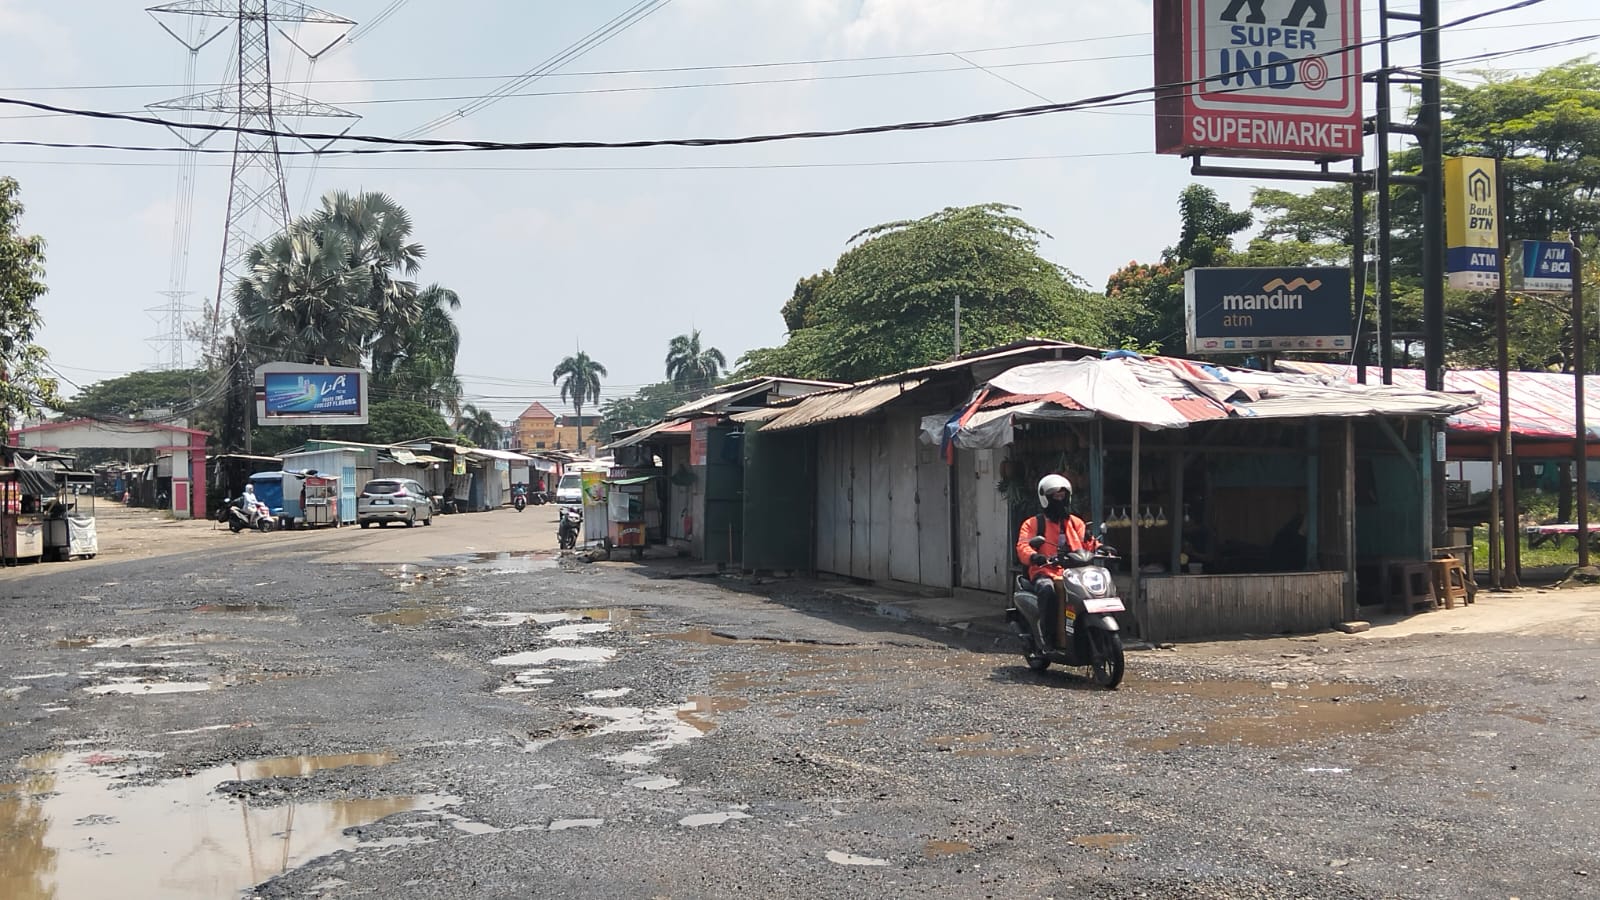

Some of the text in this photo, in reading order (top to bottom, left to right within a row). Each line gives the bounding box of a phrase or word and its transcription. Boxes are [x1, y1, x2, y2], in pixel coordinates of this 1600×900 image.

[1230, 25, 1316, 49] SUPER
[1192, 116, 1356, 148] SUPERMARKET
[1469, 203, 1493, 216] Bank
[1469, 217, 1493, 230] BTN
[1470, 253, 1495, 266] ATM
[1544, 248, 1566, 260] ATM
[1551, 262, 1570, 273] BCA
[1223, 290, 1303, 310] mandiri
[1223, 314, 1253, 327] atm
